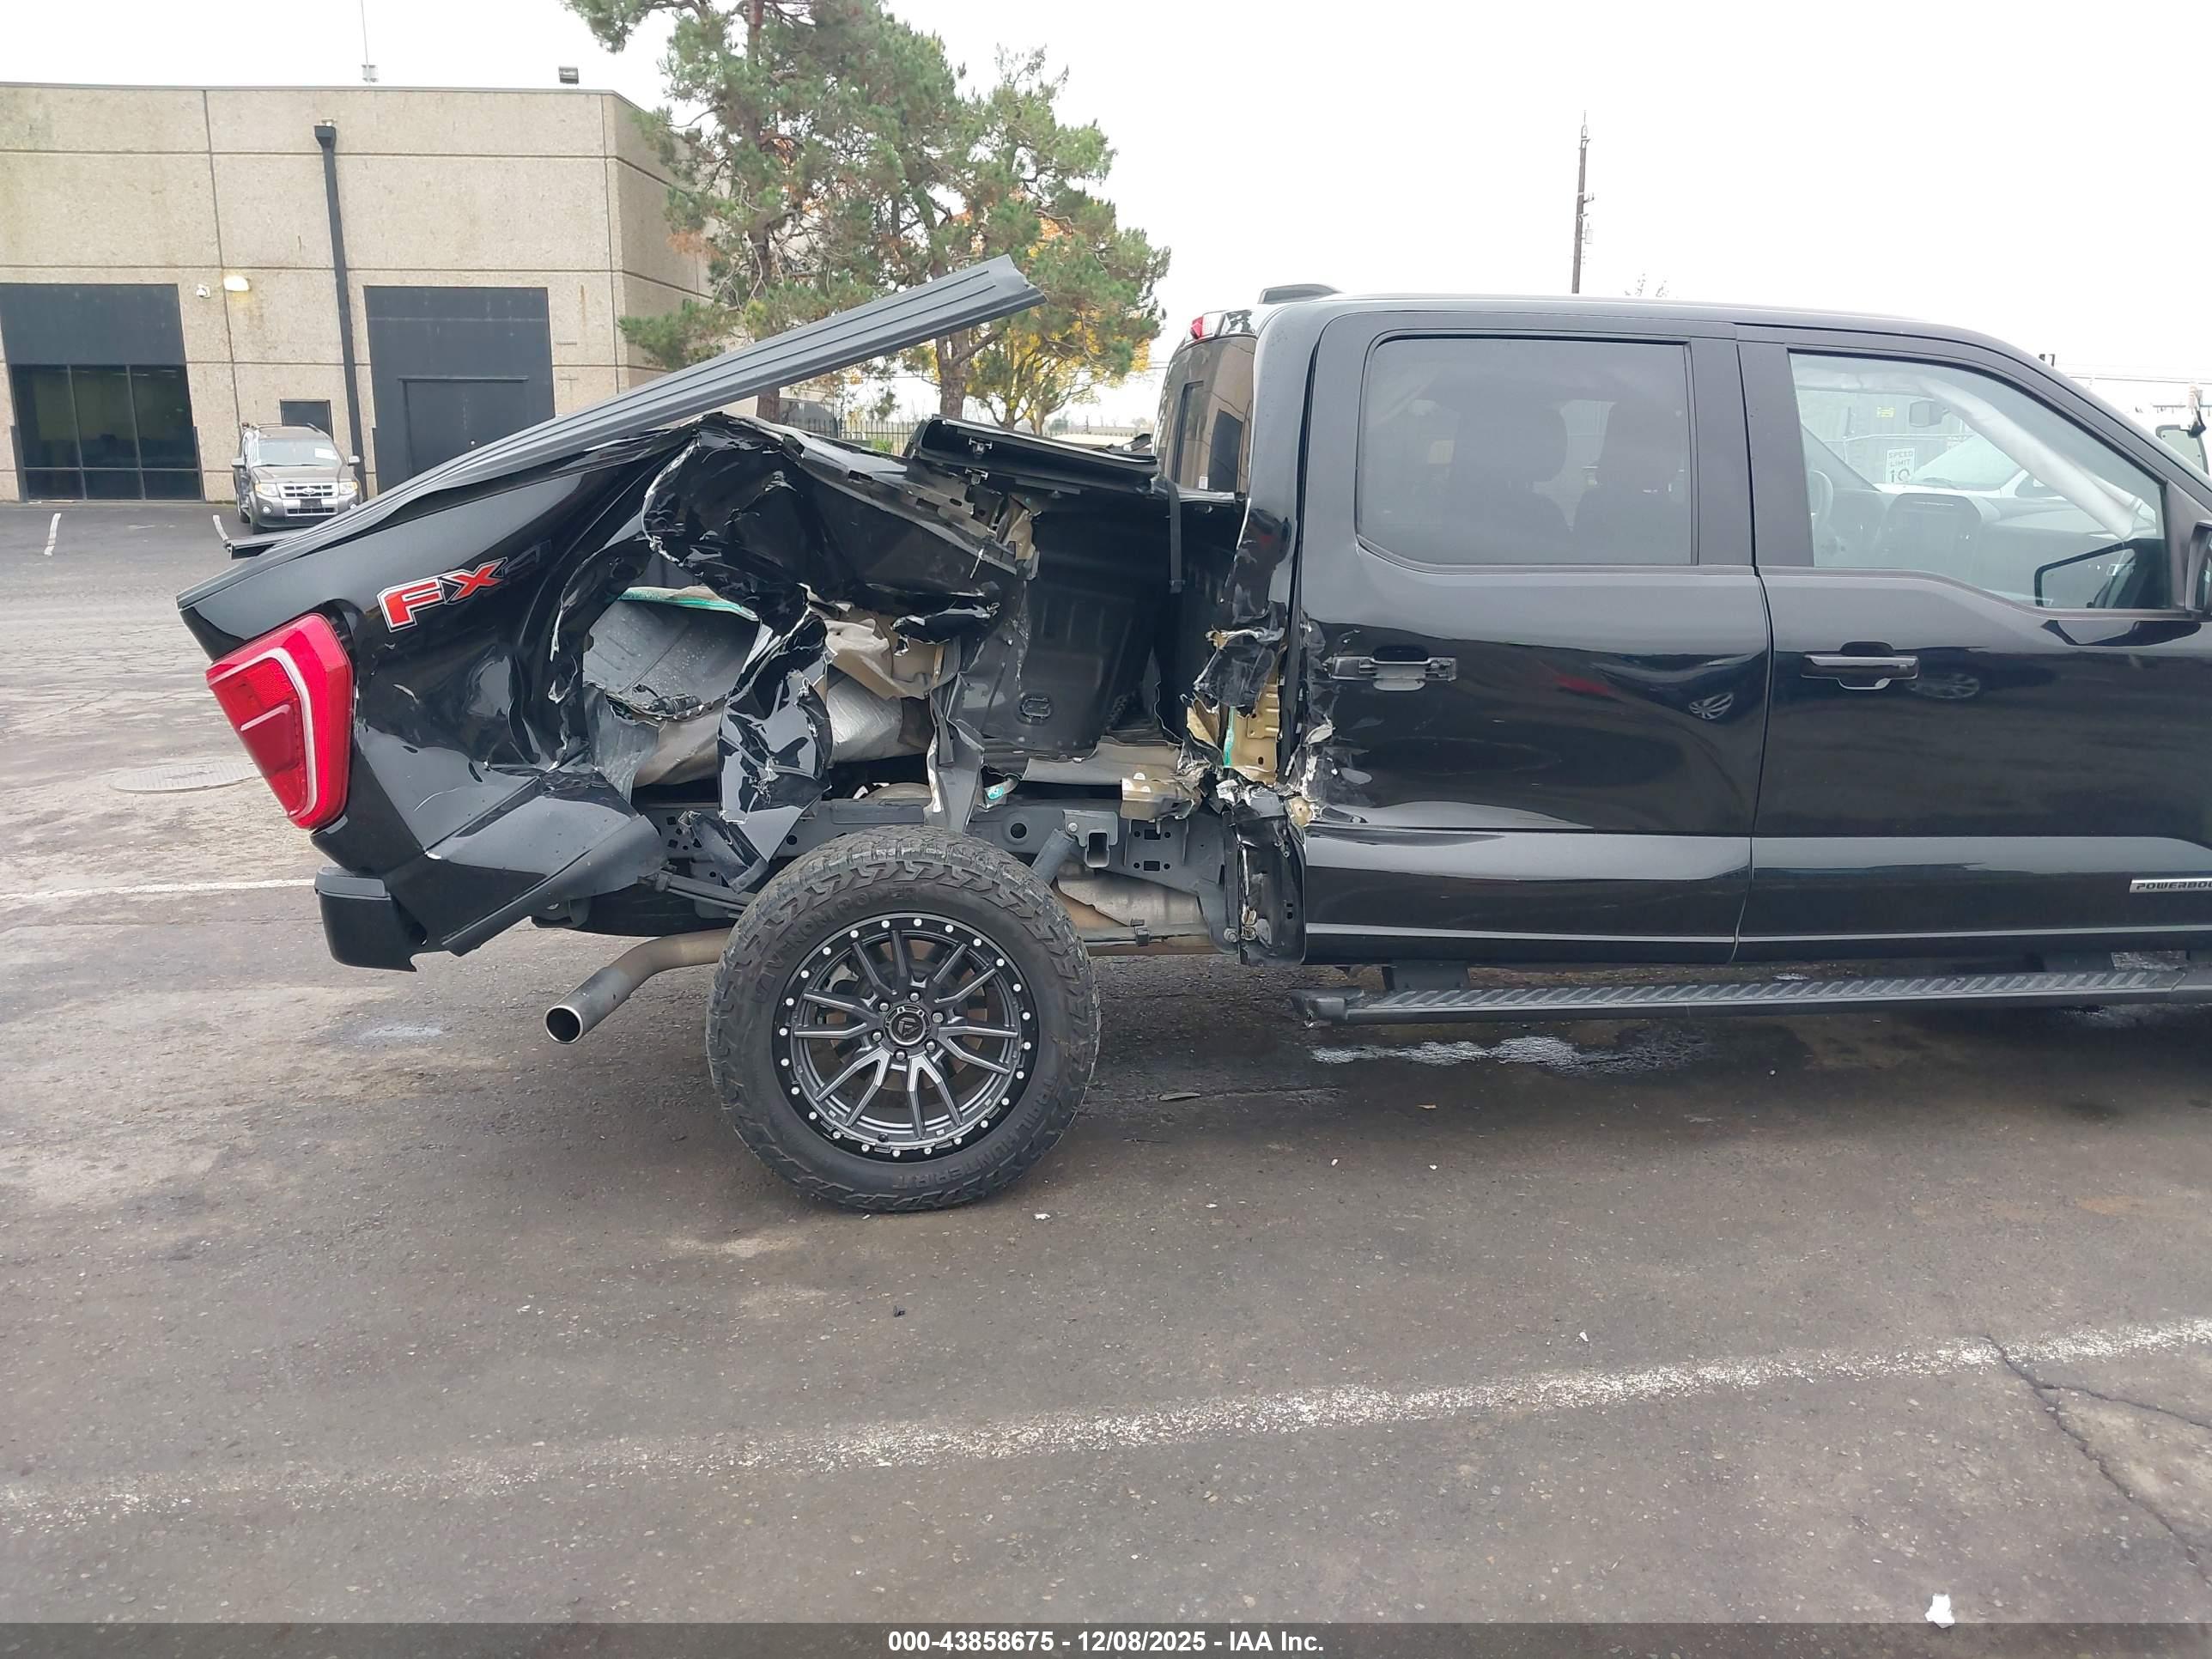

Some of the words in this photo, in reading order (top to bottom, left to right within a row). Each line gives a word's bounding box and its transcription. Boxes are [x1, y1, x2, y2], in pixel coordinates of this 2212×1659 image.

[1889, 450, 1913, 459] SPEED
[1889, 459, 1911, 467] LIMIT
[761, 909, 836, 969] VENOM
